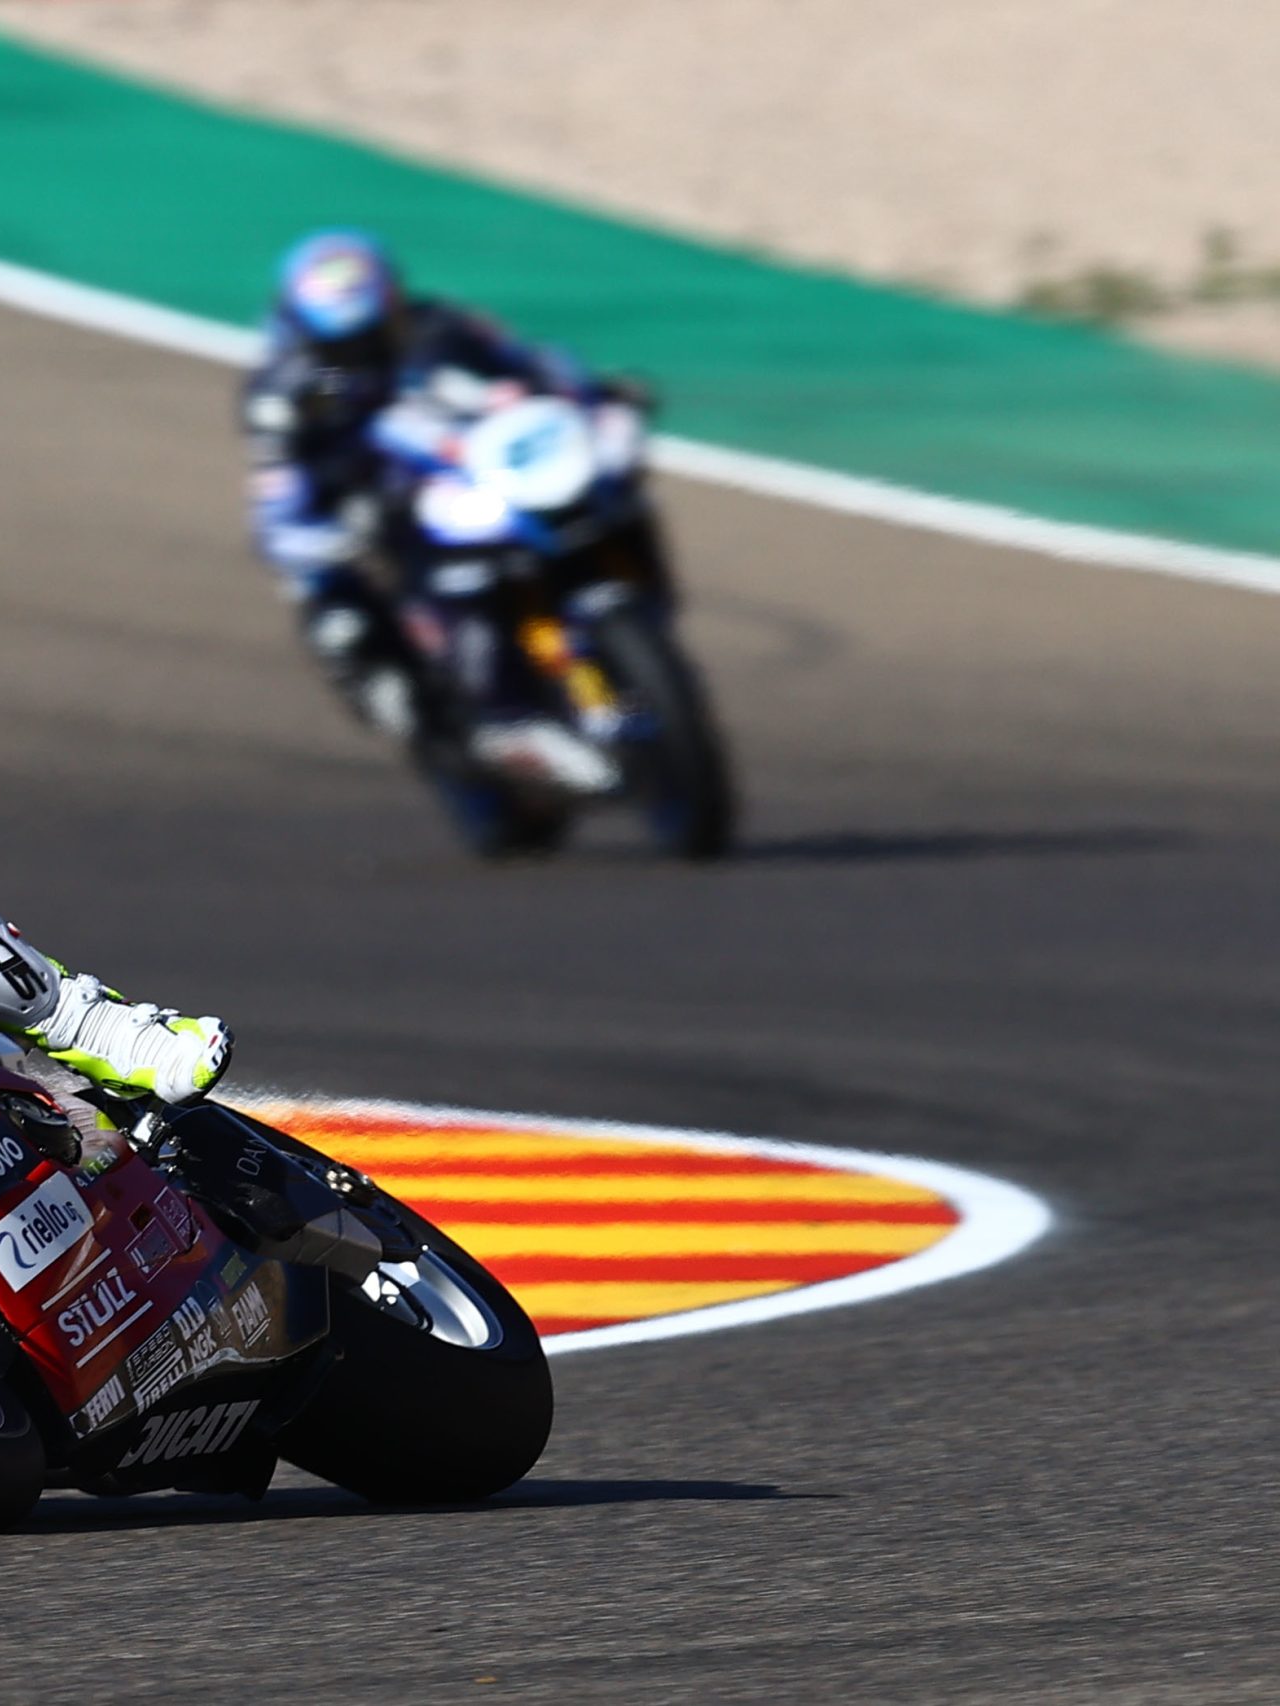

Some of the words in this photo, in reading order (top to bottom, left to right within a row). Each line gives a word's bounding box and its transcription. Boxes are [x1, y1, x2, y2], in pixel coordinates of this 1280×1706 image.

[74, 1147, 118, 1188] ALTEN
[21, 1199, 70, 1255] riello
[187, 1325, 218, 1368] NGK
[133, 1346, 188, 1416] PIRELLI
[117, 1399, 261, 1469] DUCATI
